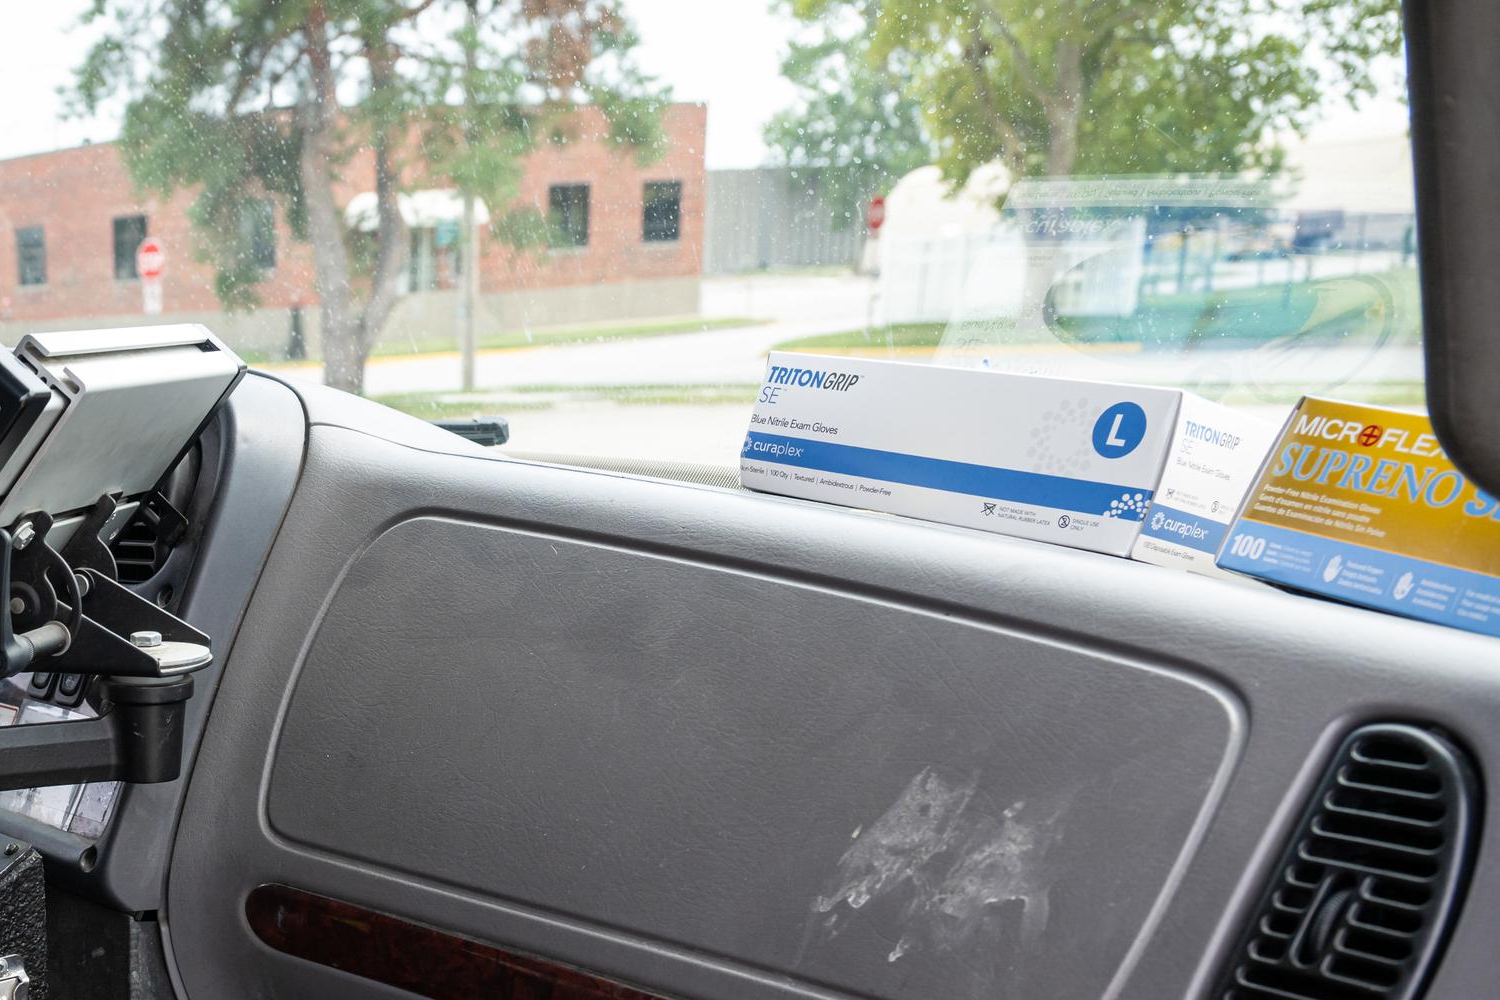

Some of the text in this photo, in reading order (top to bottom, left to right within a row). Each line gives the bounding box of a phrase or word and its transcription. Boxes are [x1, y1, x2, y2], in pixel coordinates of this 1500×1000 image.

[768, 366, 859, 391] TRITONGRIP
[759, 386, 781, 403] SE
[751, 414, 838, 434] Blue Nitrile Exam Gloves
[1106, 414, 1126, 446] L
[1186, 421, 1240, 450] TRITONGRIP
[754, 441, 801, 457] curaplex
[794, 473, 815, 483] Textured
[820, 478, 854, 490] Ambidextrous
[1273, 441, 1463, 508] SUPRENO
[1164, 518, 1205, 541] curaplex
[1230, 532, 1265, 560] 100
